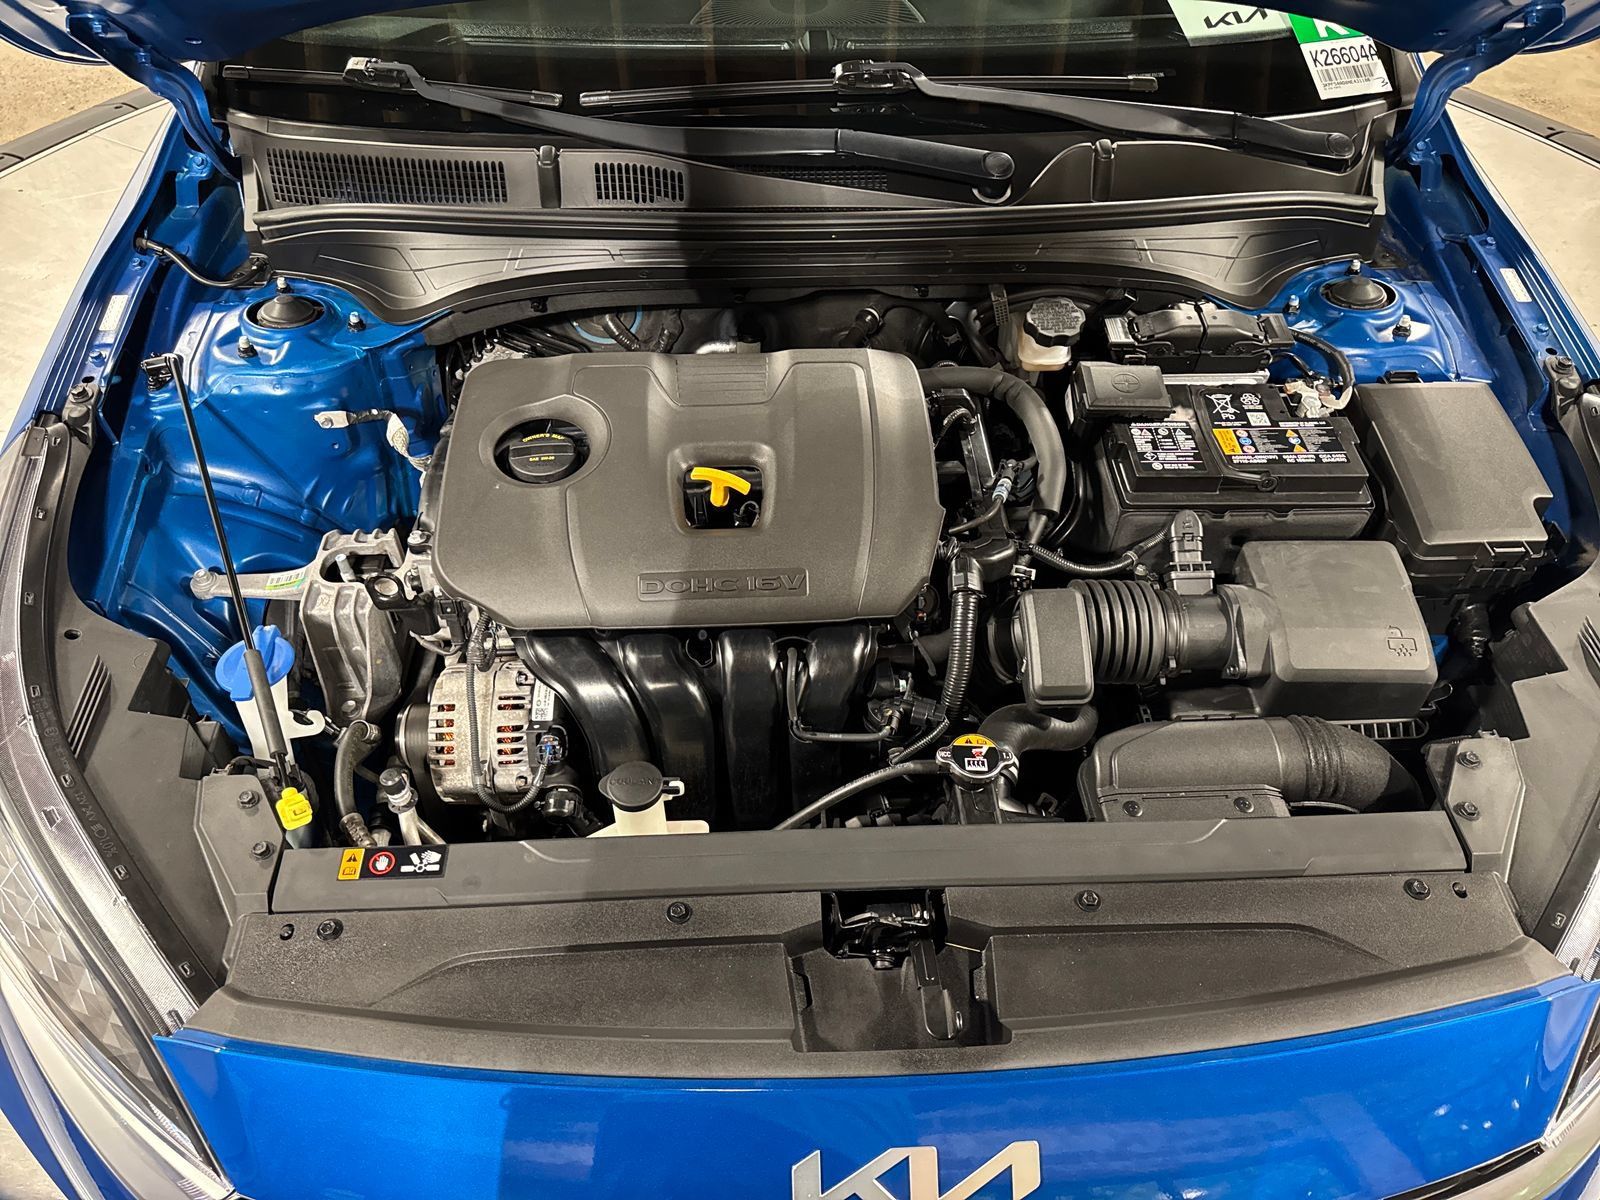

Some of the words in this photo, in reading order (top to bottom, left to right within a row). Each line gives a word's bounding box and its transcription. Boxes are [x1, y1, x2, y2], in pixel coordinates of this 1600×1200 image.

[1221, 412, 1236, 420] Pb
[640, 577, 739, 594] DOHC
[746, 574, 806, 592] 16V
